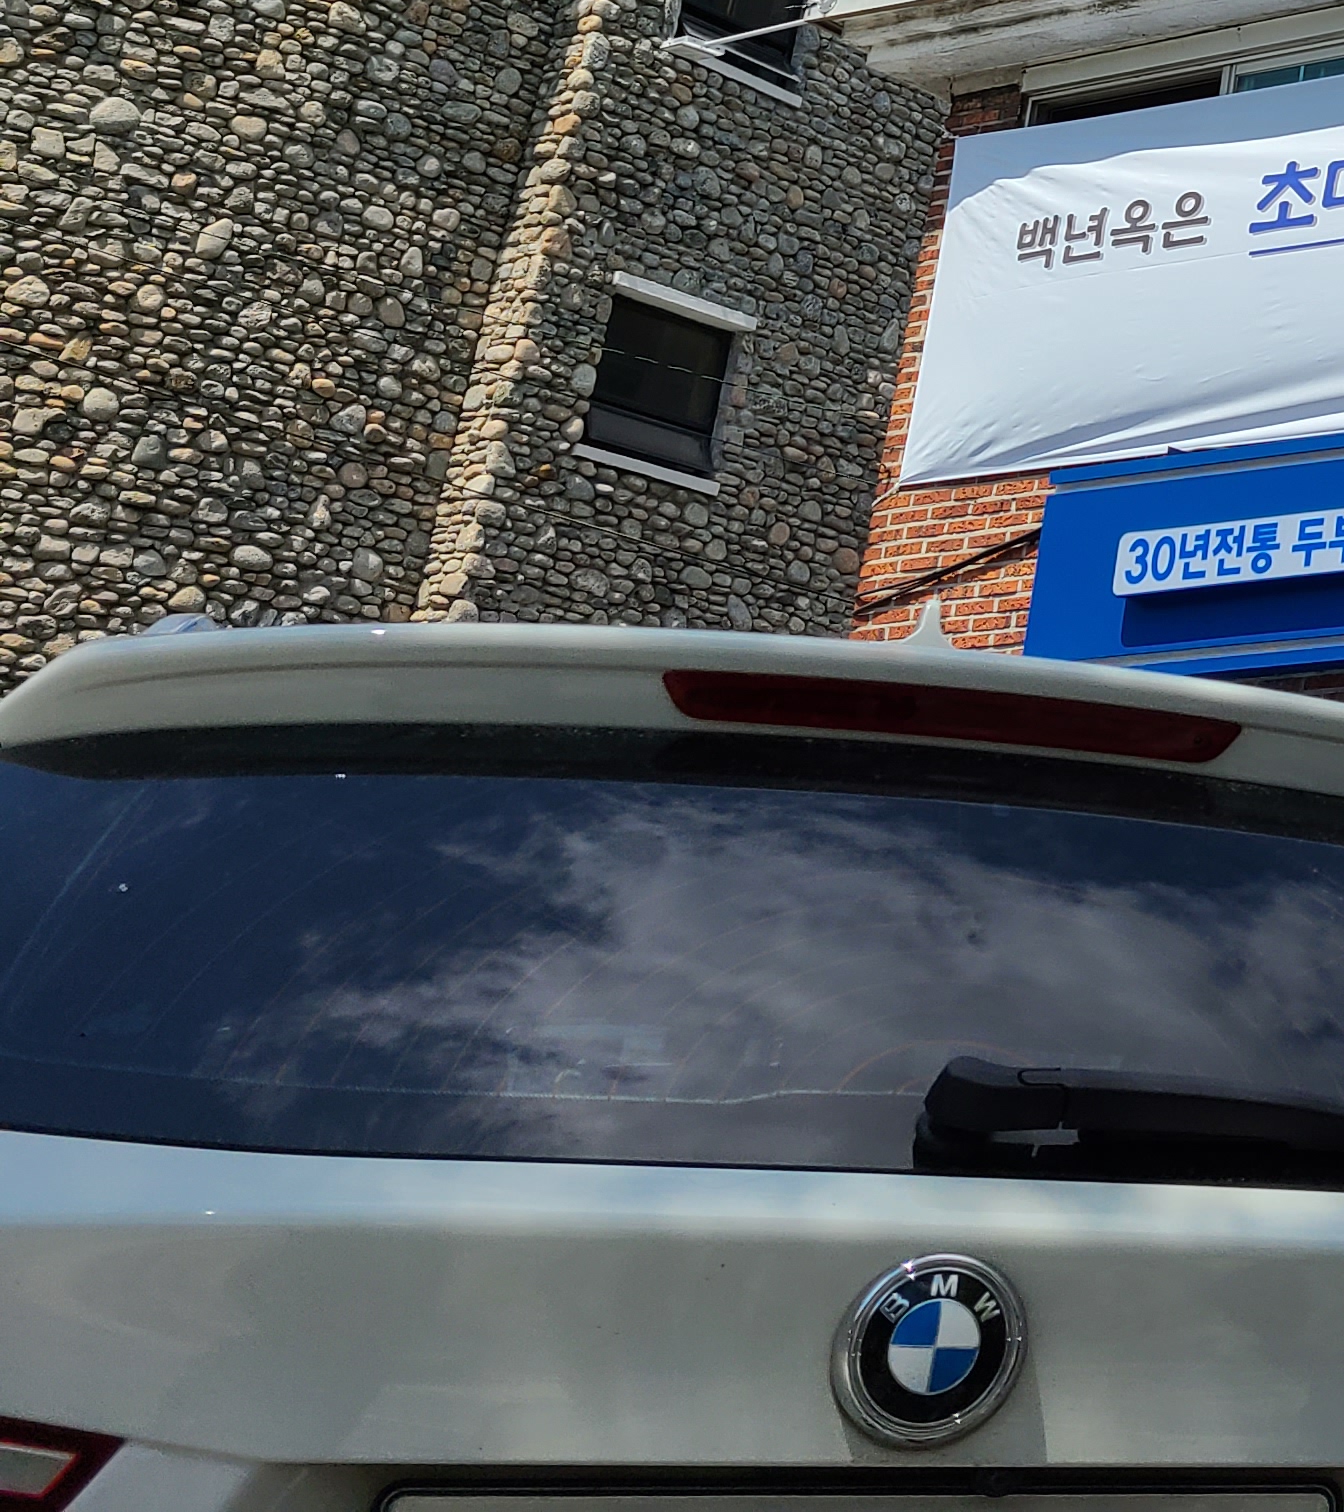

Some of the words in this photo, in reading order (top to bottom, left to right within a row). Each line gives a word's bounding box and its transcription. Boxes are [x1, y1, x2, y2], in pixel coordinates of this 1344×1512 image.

[1016, 191, 1209, 269] 백년옥은
[1124, 522, 1280, 585] 30년전통
[880, 1273, 1000, 1324] BMW
